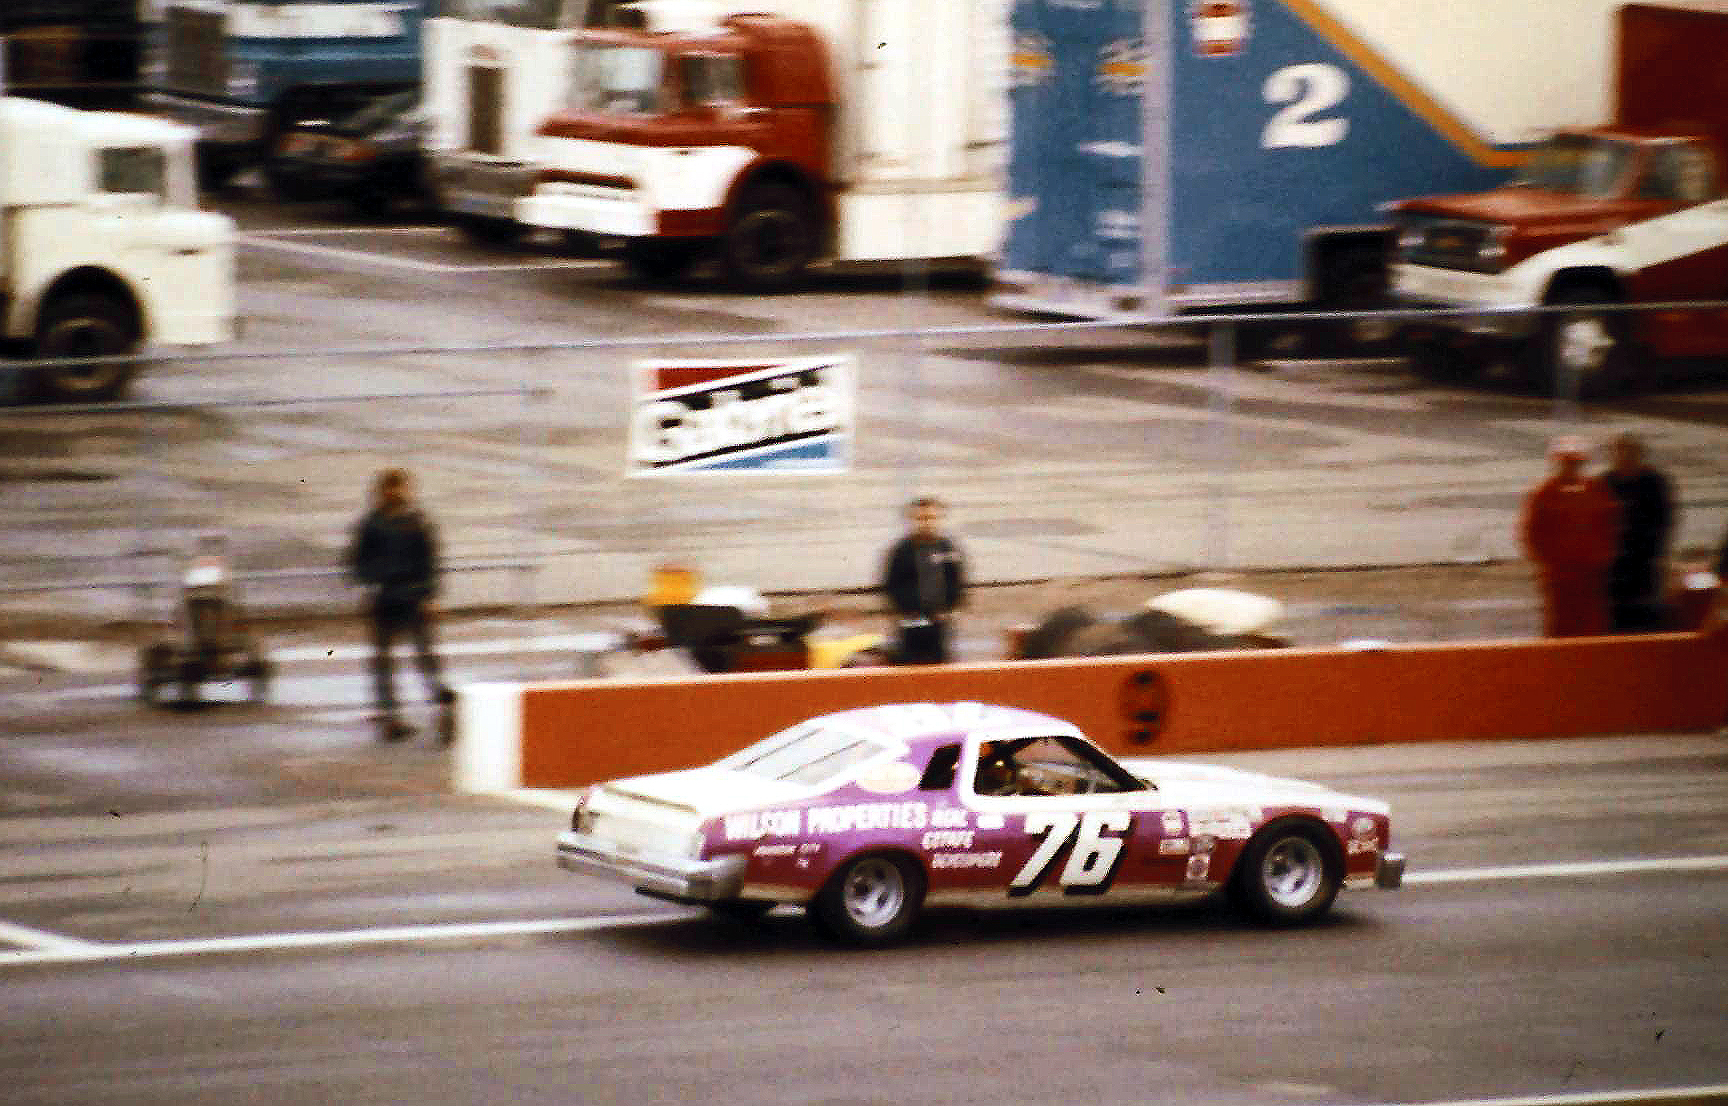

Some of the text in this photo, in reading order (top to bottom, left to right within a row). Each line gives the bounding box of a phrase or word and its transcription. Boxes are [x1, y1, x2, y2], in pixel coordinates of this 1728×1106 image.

[1260, 63, 1350, 149] 2
[807, 801, 928, 833] PROPERTIES
[1009, 811, 1132, 891] 76
